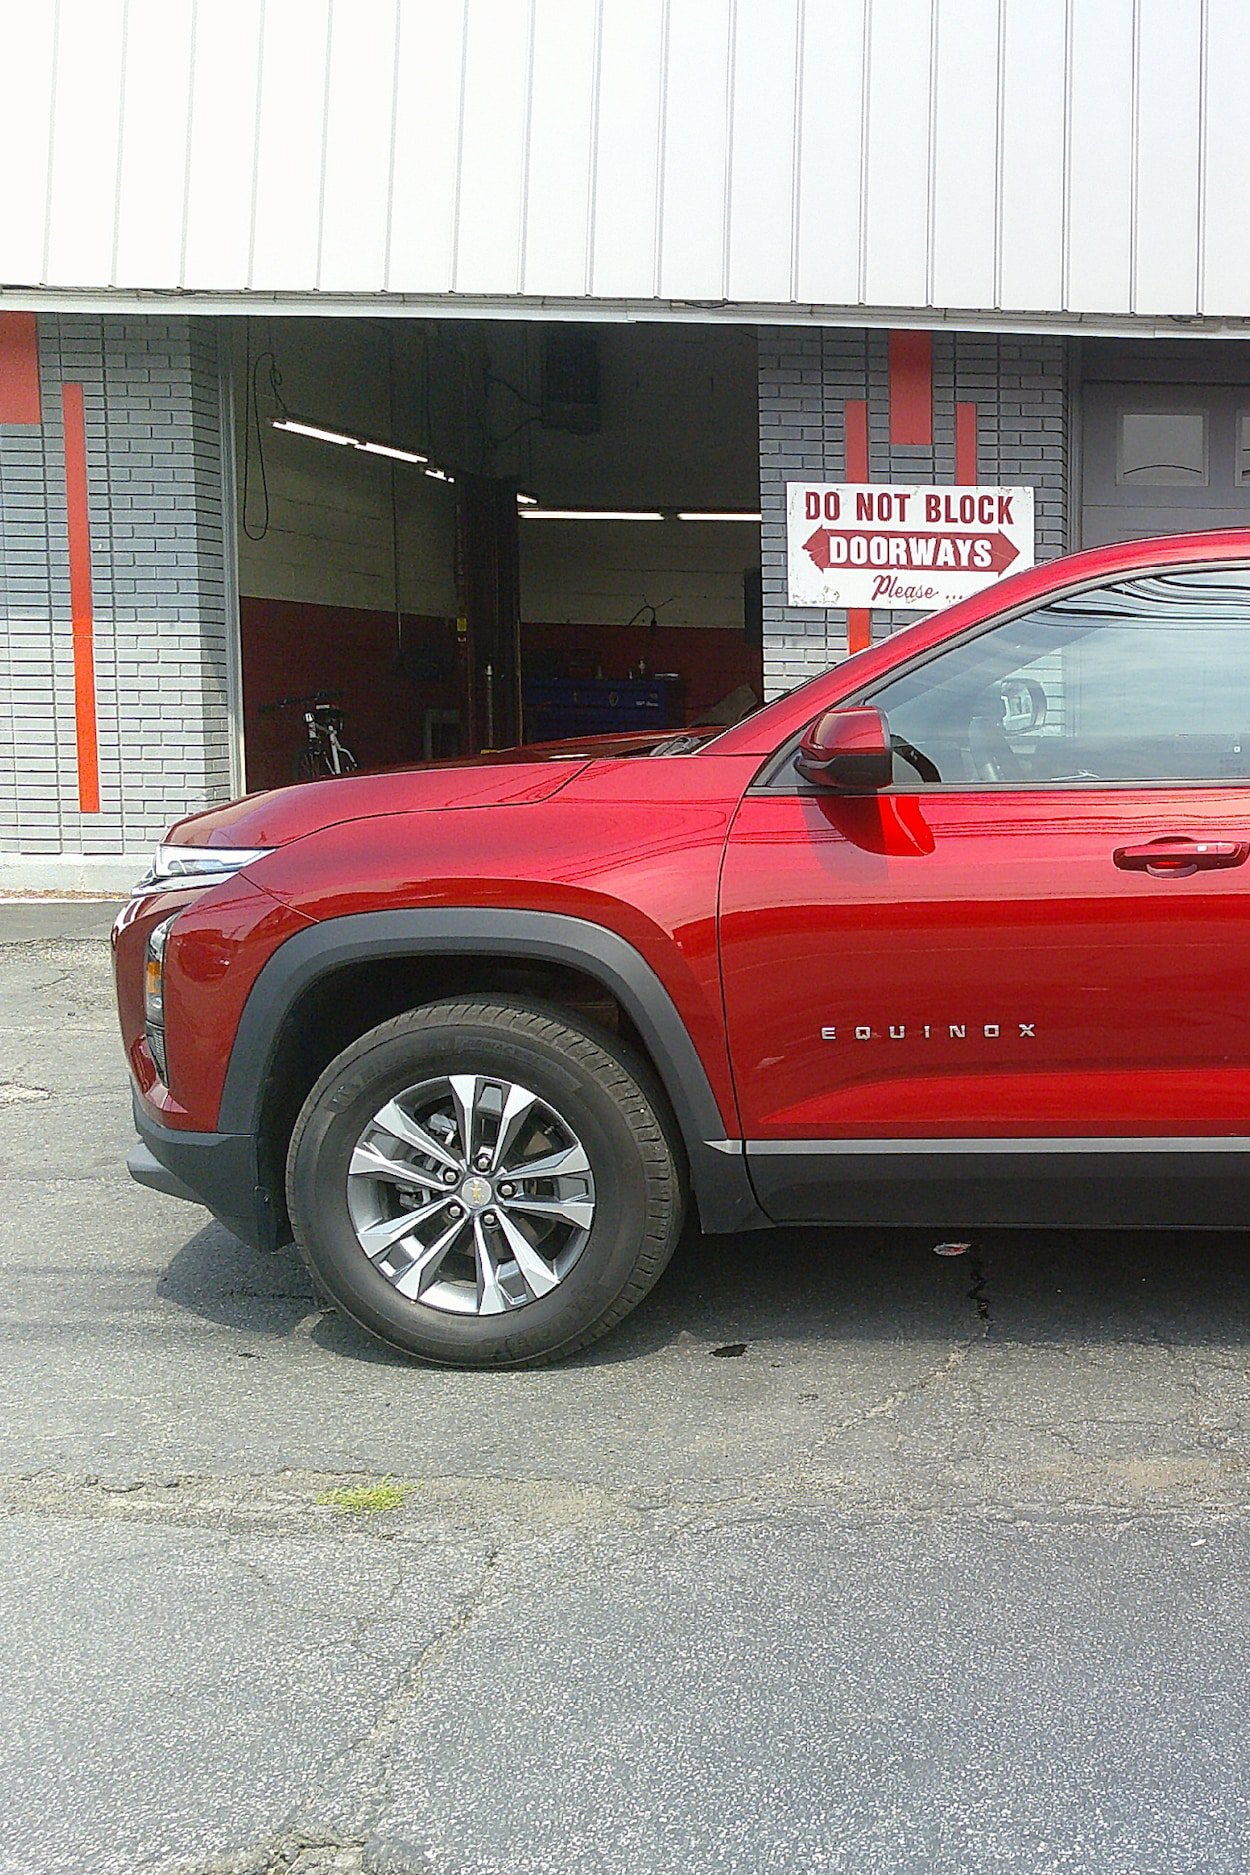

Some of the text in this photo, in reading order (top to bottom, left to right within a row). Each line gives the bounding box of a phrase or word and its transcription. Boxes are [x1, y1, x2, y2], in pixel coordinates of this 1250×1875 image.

[805, 491, 1015, 525] DO NOT BLOCK
[829, 536, 992, 567] DOORWAYS
[871, 574, 940, 601] Please
[820, 1023, 1036, 1040] EQUINOX
